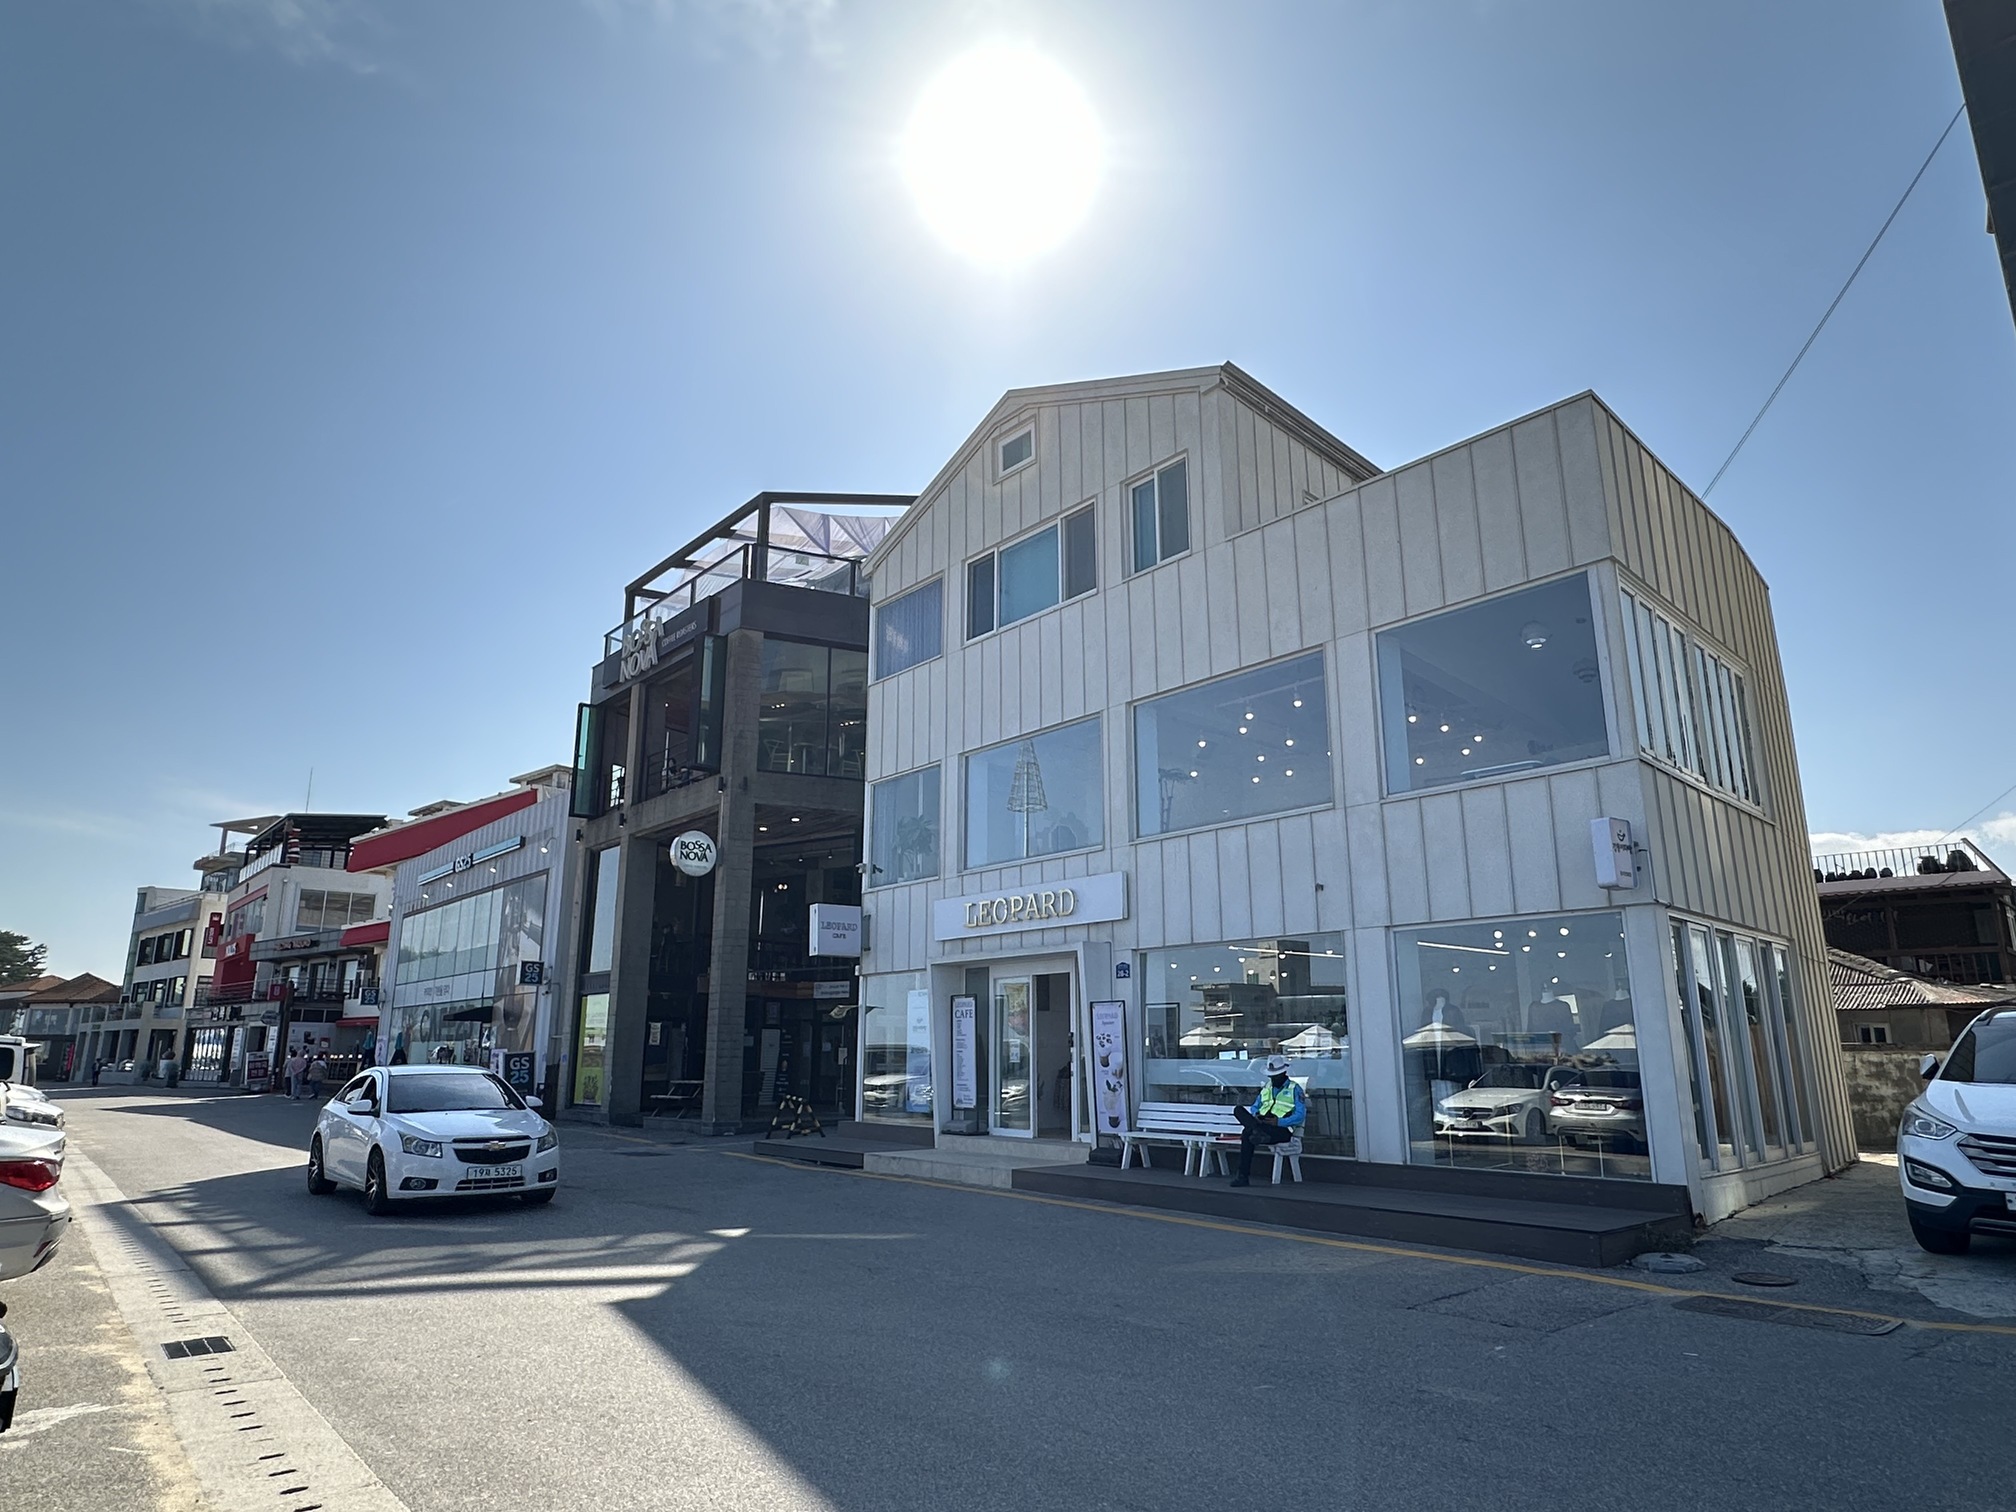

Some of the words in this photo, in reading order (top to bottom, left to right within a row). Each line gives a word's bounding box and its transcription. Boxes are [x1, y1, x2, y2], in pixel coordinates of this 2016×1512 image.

[622, 616, 665, 658] BOSSA
[619, 633, 658, 682] NOVA
[680, 840, 712, 853] BOSSA
[680, 850, 709, 862] NOVA
[454, 853, 472, 873] GS25
[964, 888, 1076, 928] LEOPARD
[820, 921, 858, 932] LEOPARD
[525, 963, 540, 973] GS
[524, 973, 539, 982] 25
[954, 1009, 973, 1019] CAFE
[509, 1057, 530, 1070] GS
[510, 1070, 530, 1084] 25
[494, 1166, 517, 1176] 5325
